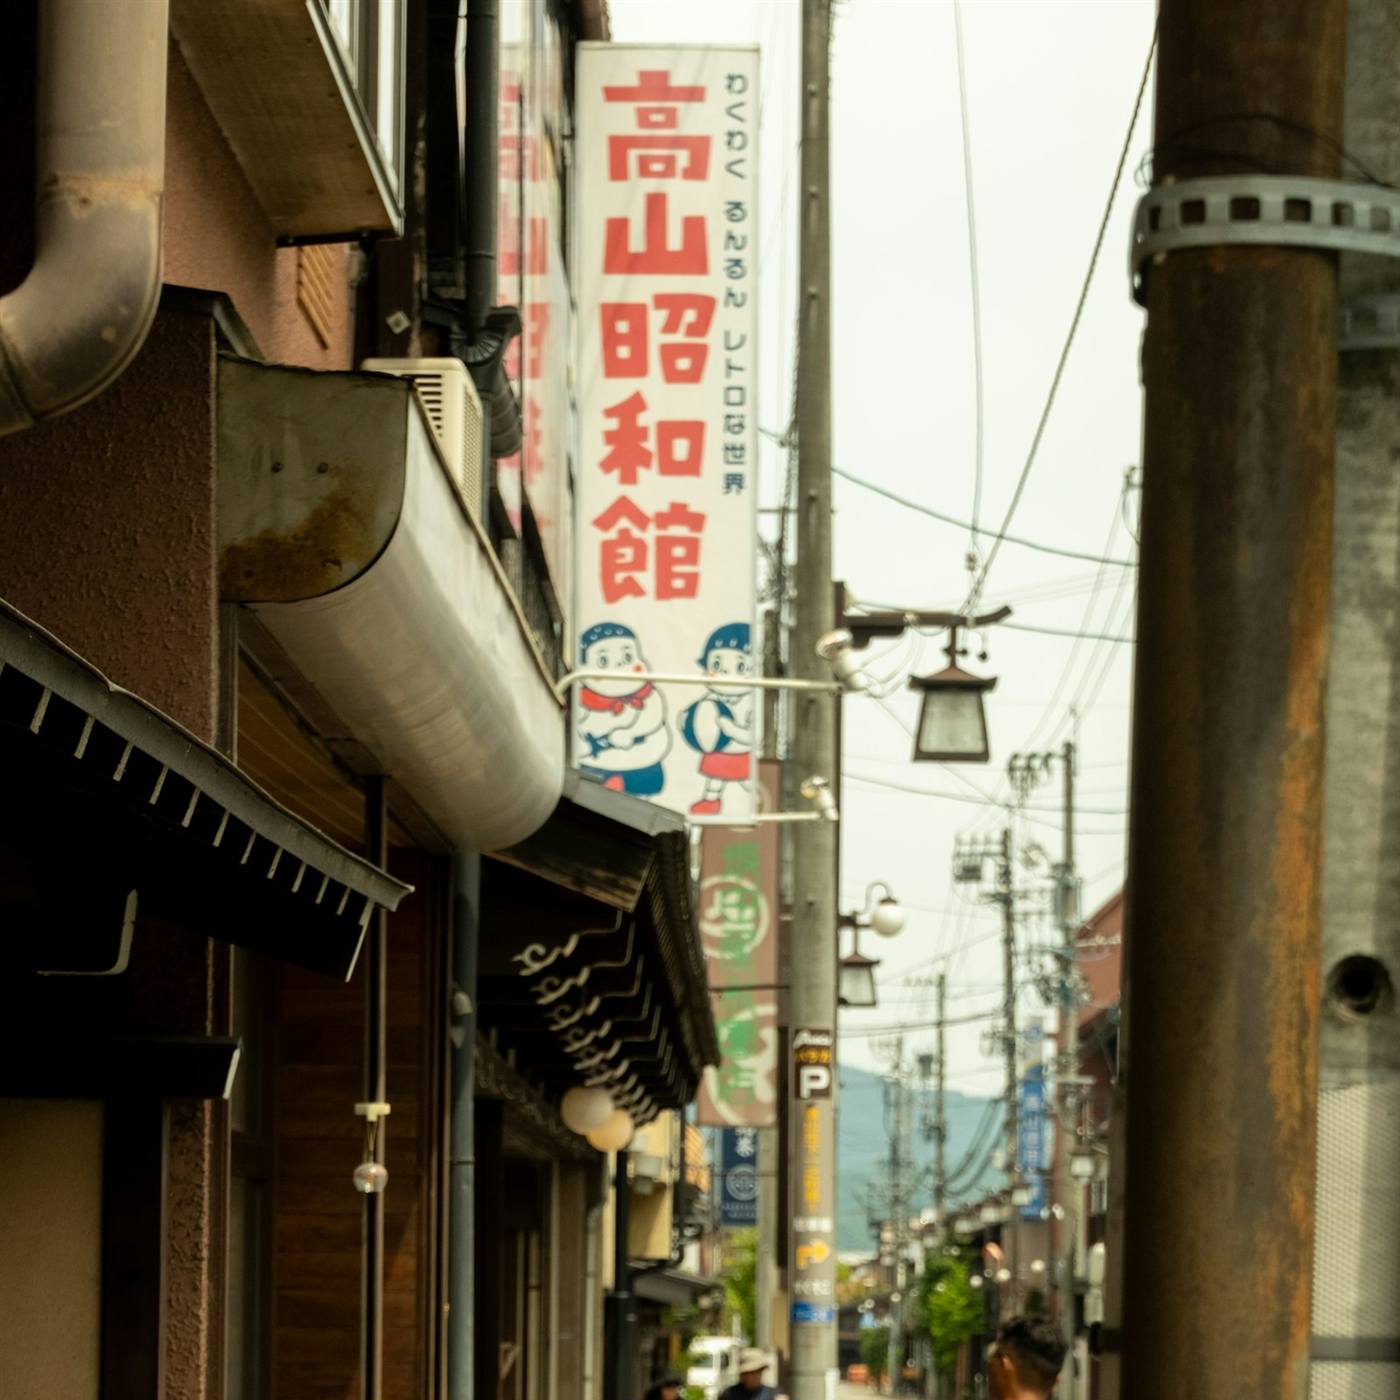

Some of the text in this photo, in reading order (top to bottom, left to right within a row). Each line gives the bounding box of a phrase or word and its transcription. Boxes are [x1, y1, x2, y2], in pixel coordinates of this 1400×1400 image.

[591, 70, 716, 604] 高山昭和館
[723, 72, 748, 496] わくわく るんるん レトロな世界
[800, 1065, 830, 1099] P
